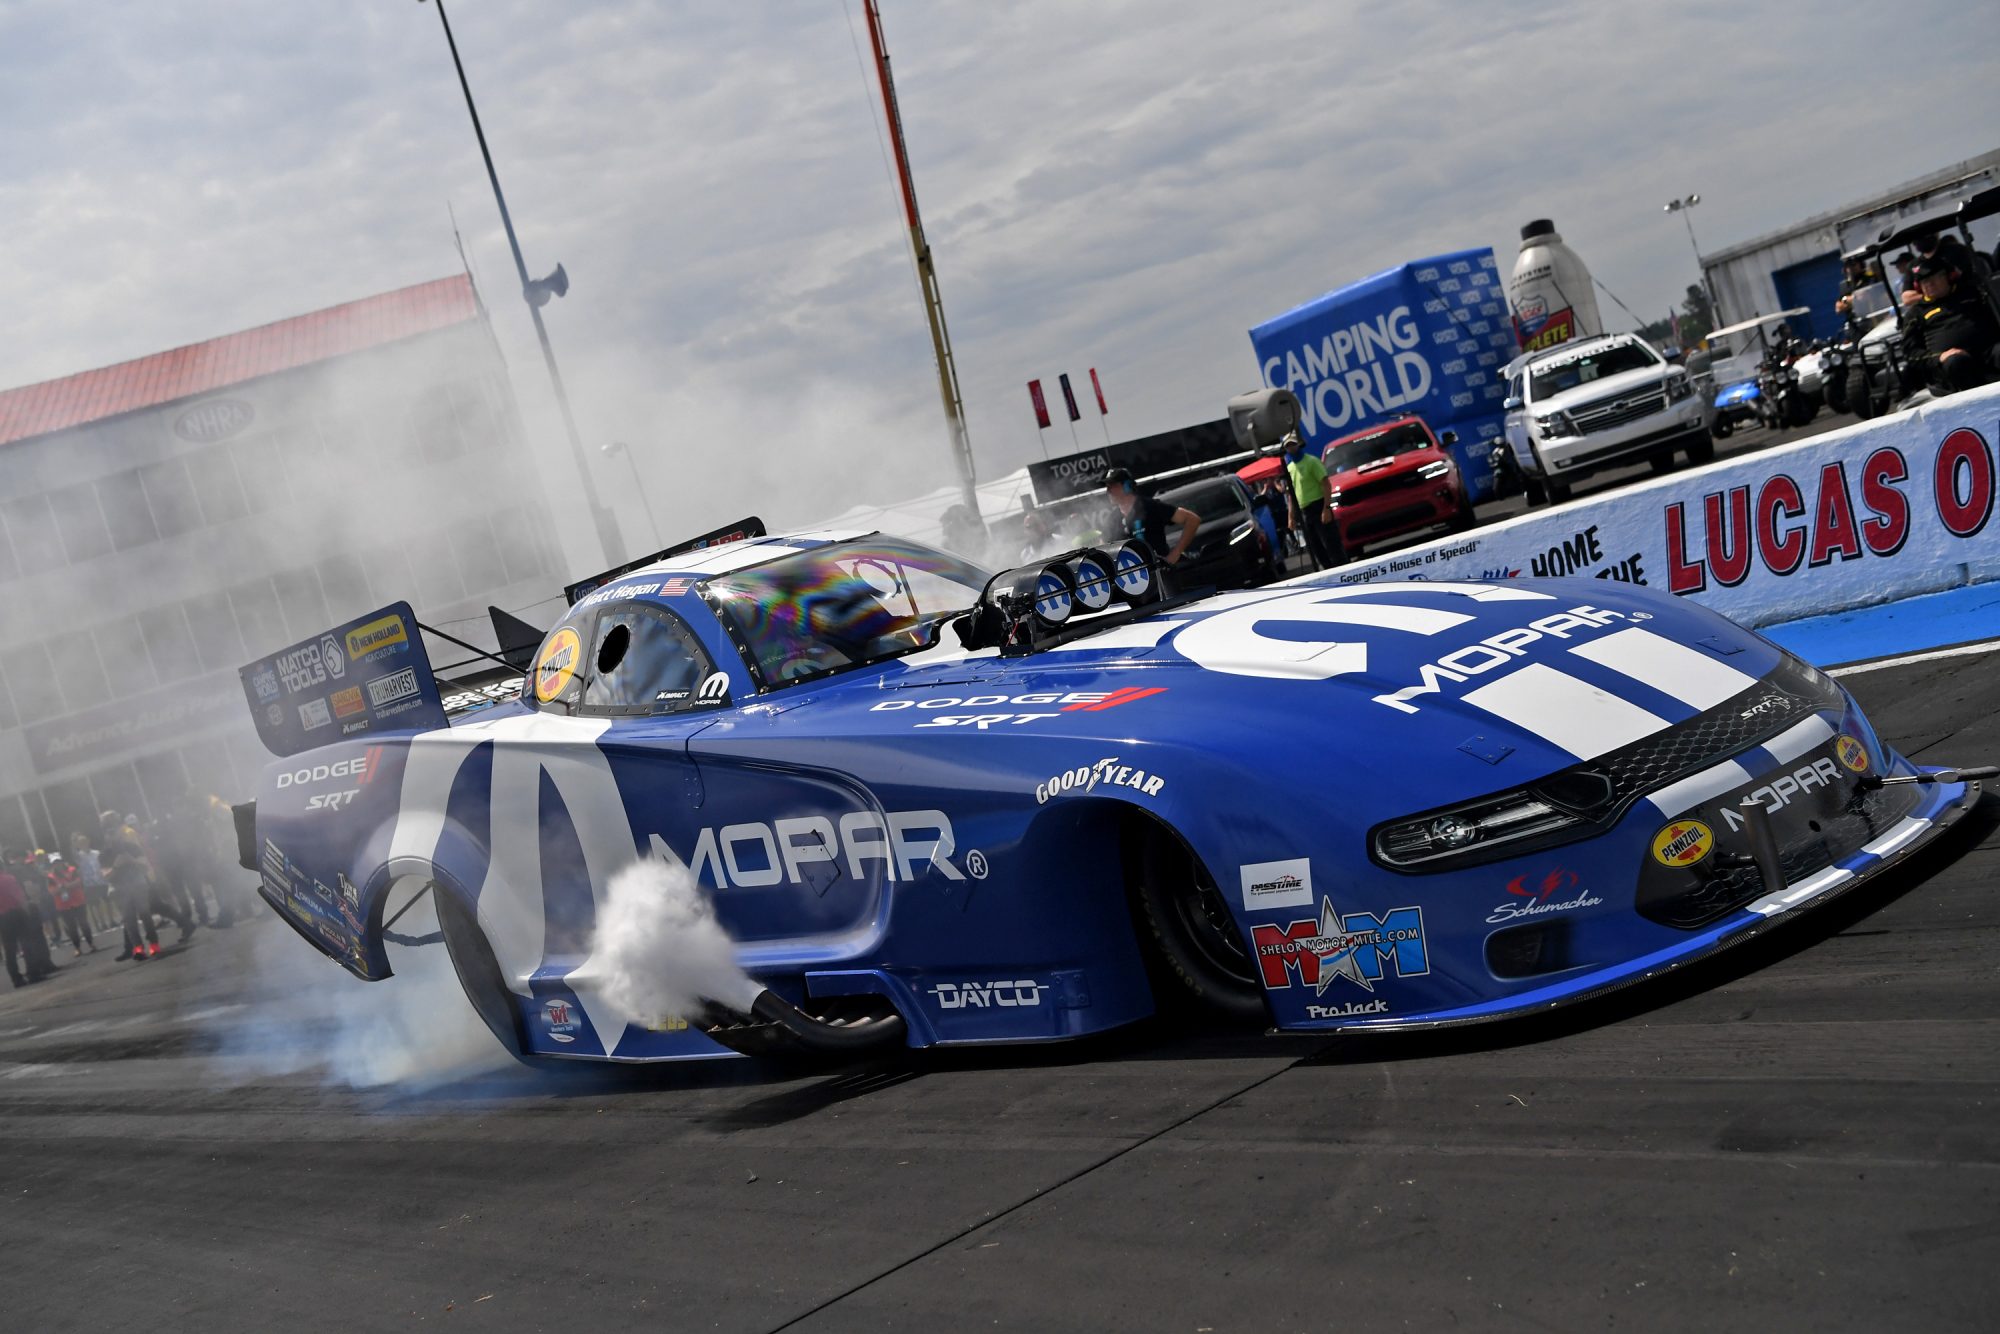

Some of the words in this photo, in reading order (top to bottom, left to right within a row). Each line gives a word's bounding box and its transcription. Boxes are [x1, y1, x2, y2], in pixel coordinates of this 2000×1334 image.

[1263, 305, 1421, 392] CAMPING
[1298, 352, 1432, 437] WORLD
[186, 405, 245, 435] NHRA
[1050, 454, 1107, 480] TOYOTA
[1664, 446, 1910, 595] LUCAS
[1934, 427, 2000, 538] O
[1340, 566, 1387, 583] Georgia's
[1390, 558, 1422, 573] House
[1425, 552, 1436, 564] of
[1440, 542, 1477, 561] Speed!
[1531, 525, 1603, 577] HOME
[580, 590, 613, 609] Matt
[613, 583, 661, 601] Hagan
[373, 623, 400, 645] HOLLAND
[276, 644, 321, 677] MATCO
[538, 645, 573, 685] PENNZOIL
[1371, 604, 1644, 714] MOPAR
[281, 663, 327, 694] TOOLS
[369, 671, 416, 707] TRUHARVEST
[869, 692, 1113, 711] DODGE
[1740, 699, 1772, 720] SRT
[913, 713, 1060, 730] SRT
[277, 757, 367, 789] DODGE
[1036, 757, 1164, 805] GOODYEAR
[304, 789, 360, 811] SRT
[1719, 756, 1843, 832] MOPAR
[649, 809, 967, 890] MOPAR
[1661, 826, 1704, 861] PENNZOIL
[1485, 890, 1603, 924] Schumacher
[1260, 941, 1302, 956] SHELOR
[1306, 936, 1348, 951] MOTOR
[1352, 927, 1420, 946] MILE.COM
[931, 980, 1045, 1009] DAYCO
